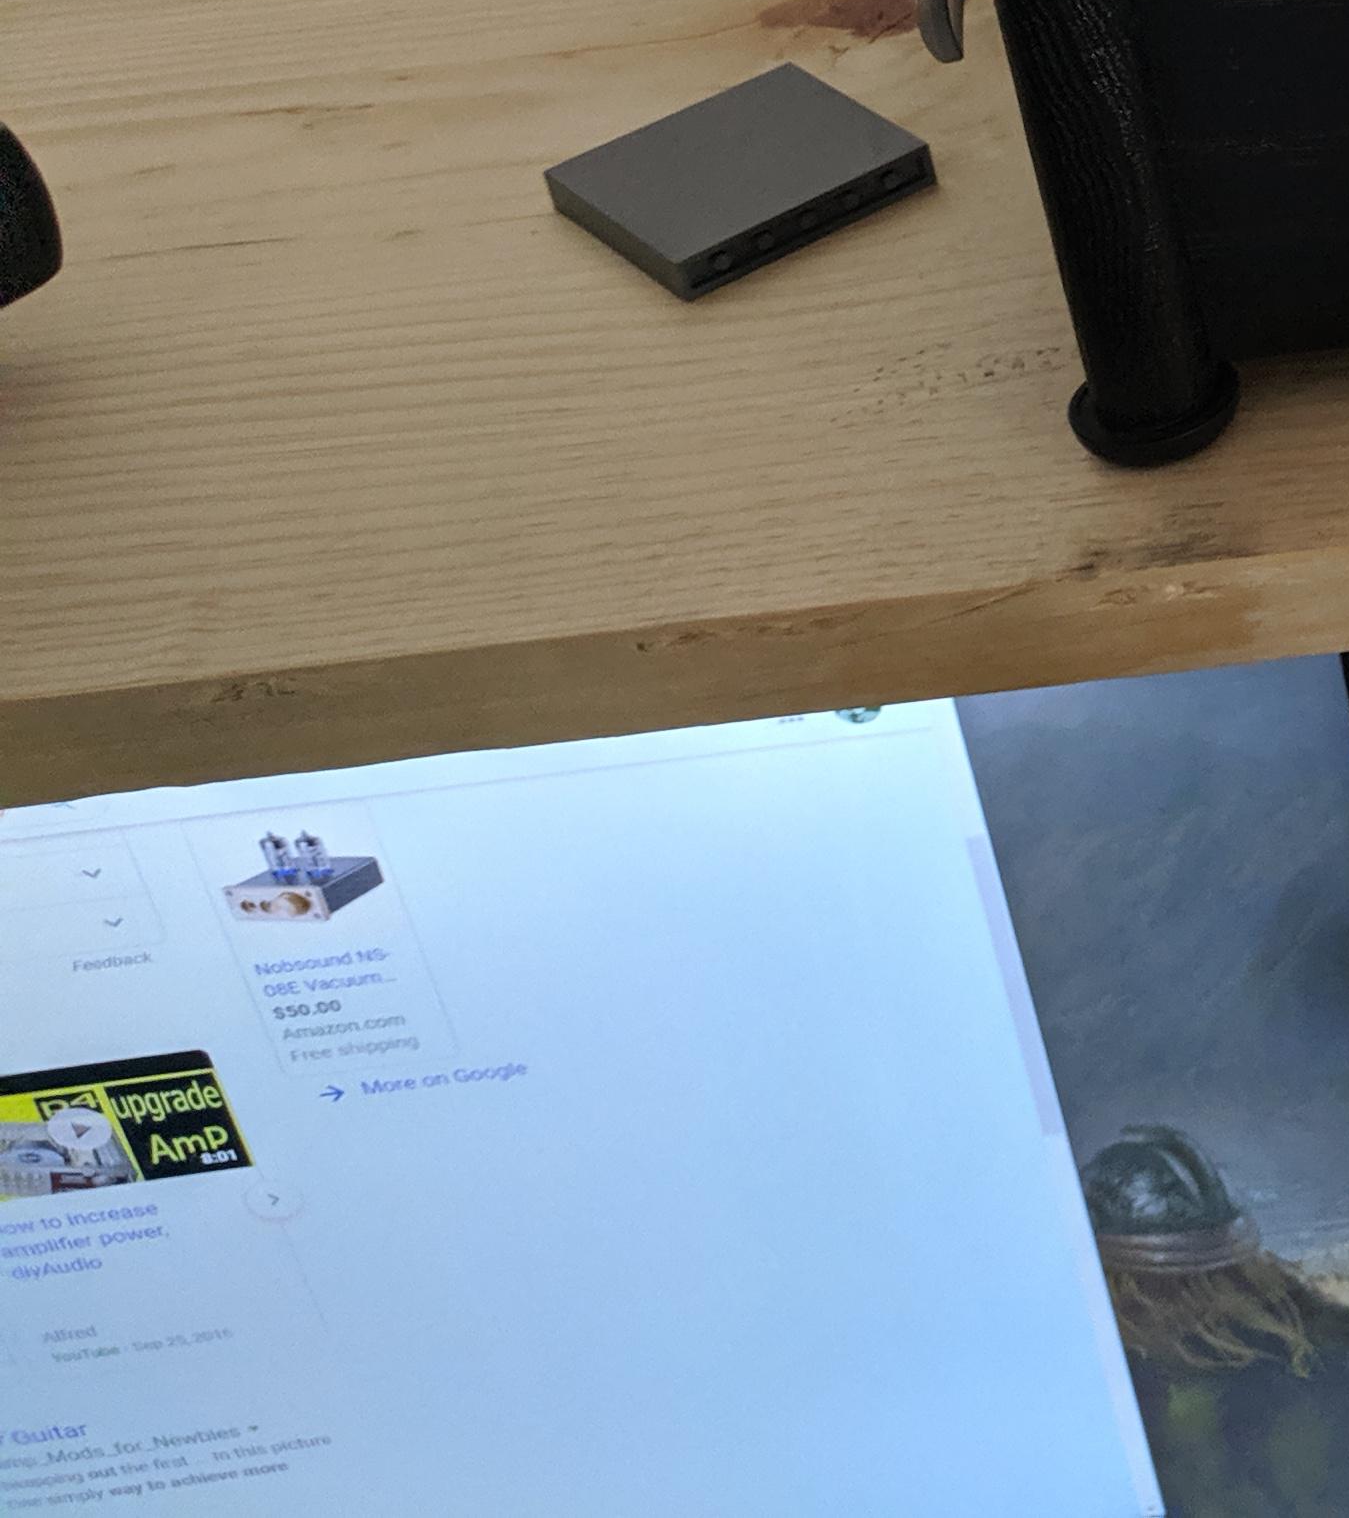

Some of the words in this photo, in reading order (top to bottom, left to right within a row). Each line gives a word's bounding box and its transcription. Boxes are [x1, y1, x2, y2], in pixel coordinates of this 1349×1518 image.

[73, 951, 152, 972] Feedback
[254, 951, 352, 976] Nobsound
[272, 999, 342, 1020] $50.00
[282, 1013, 406, 1041] Amazon.com
[290, 1048, 334, 1063] Free
[338, 1035, 420, 1059] shipping
[361, 1079, 417, 1096] More
[421, 1073, 449, 1088] on
[452, 1062, 529, 1085] Google
[110, 1079, 223, 1124] upgrade
[200, 1148, 238, 1165] 8:01
[0, 1220, 35, 1236] ow
[40, 1216, 62, 1231] to
[1, 1235, 92, 1260] amplifier
[99, 1225, 170, 1248] power,
[11, 1256, 103, 1280] diyAudio
[11, 1424, 87, 1445] Guitar
[270, 1435, 332, 1455] picture
[170, 1469, 238, 1488] achieve
[242, 1461, 290, 1477] more
